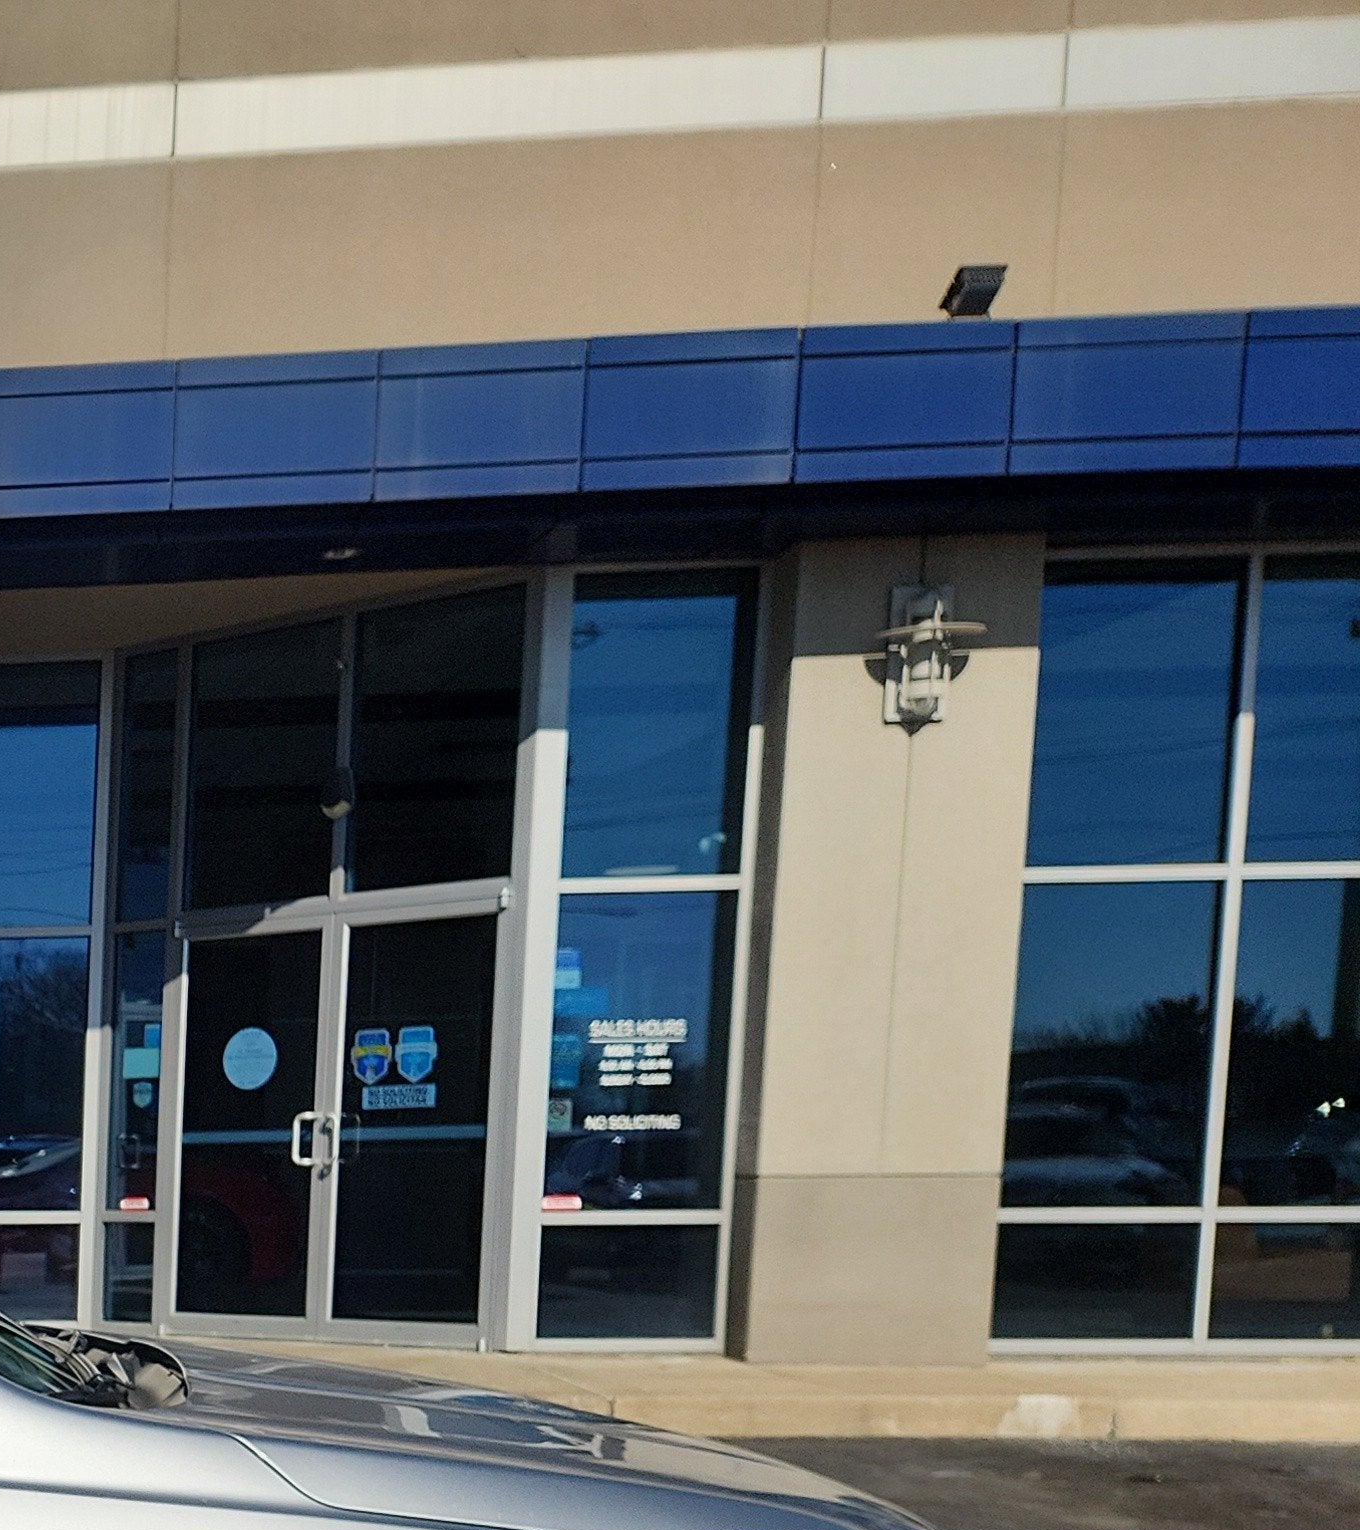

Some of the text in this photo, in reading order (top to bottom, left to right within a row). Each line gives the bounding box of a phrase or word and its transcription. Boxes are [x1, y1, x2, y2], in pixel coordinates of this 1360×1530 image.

[589, 1019, 688, 1038] SALES HOURS
[584, 1114, 681, 1131] NO SOLICITING
